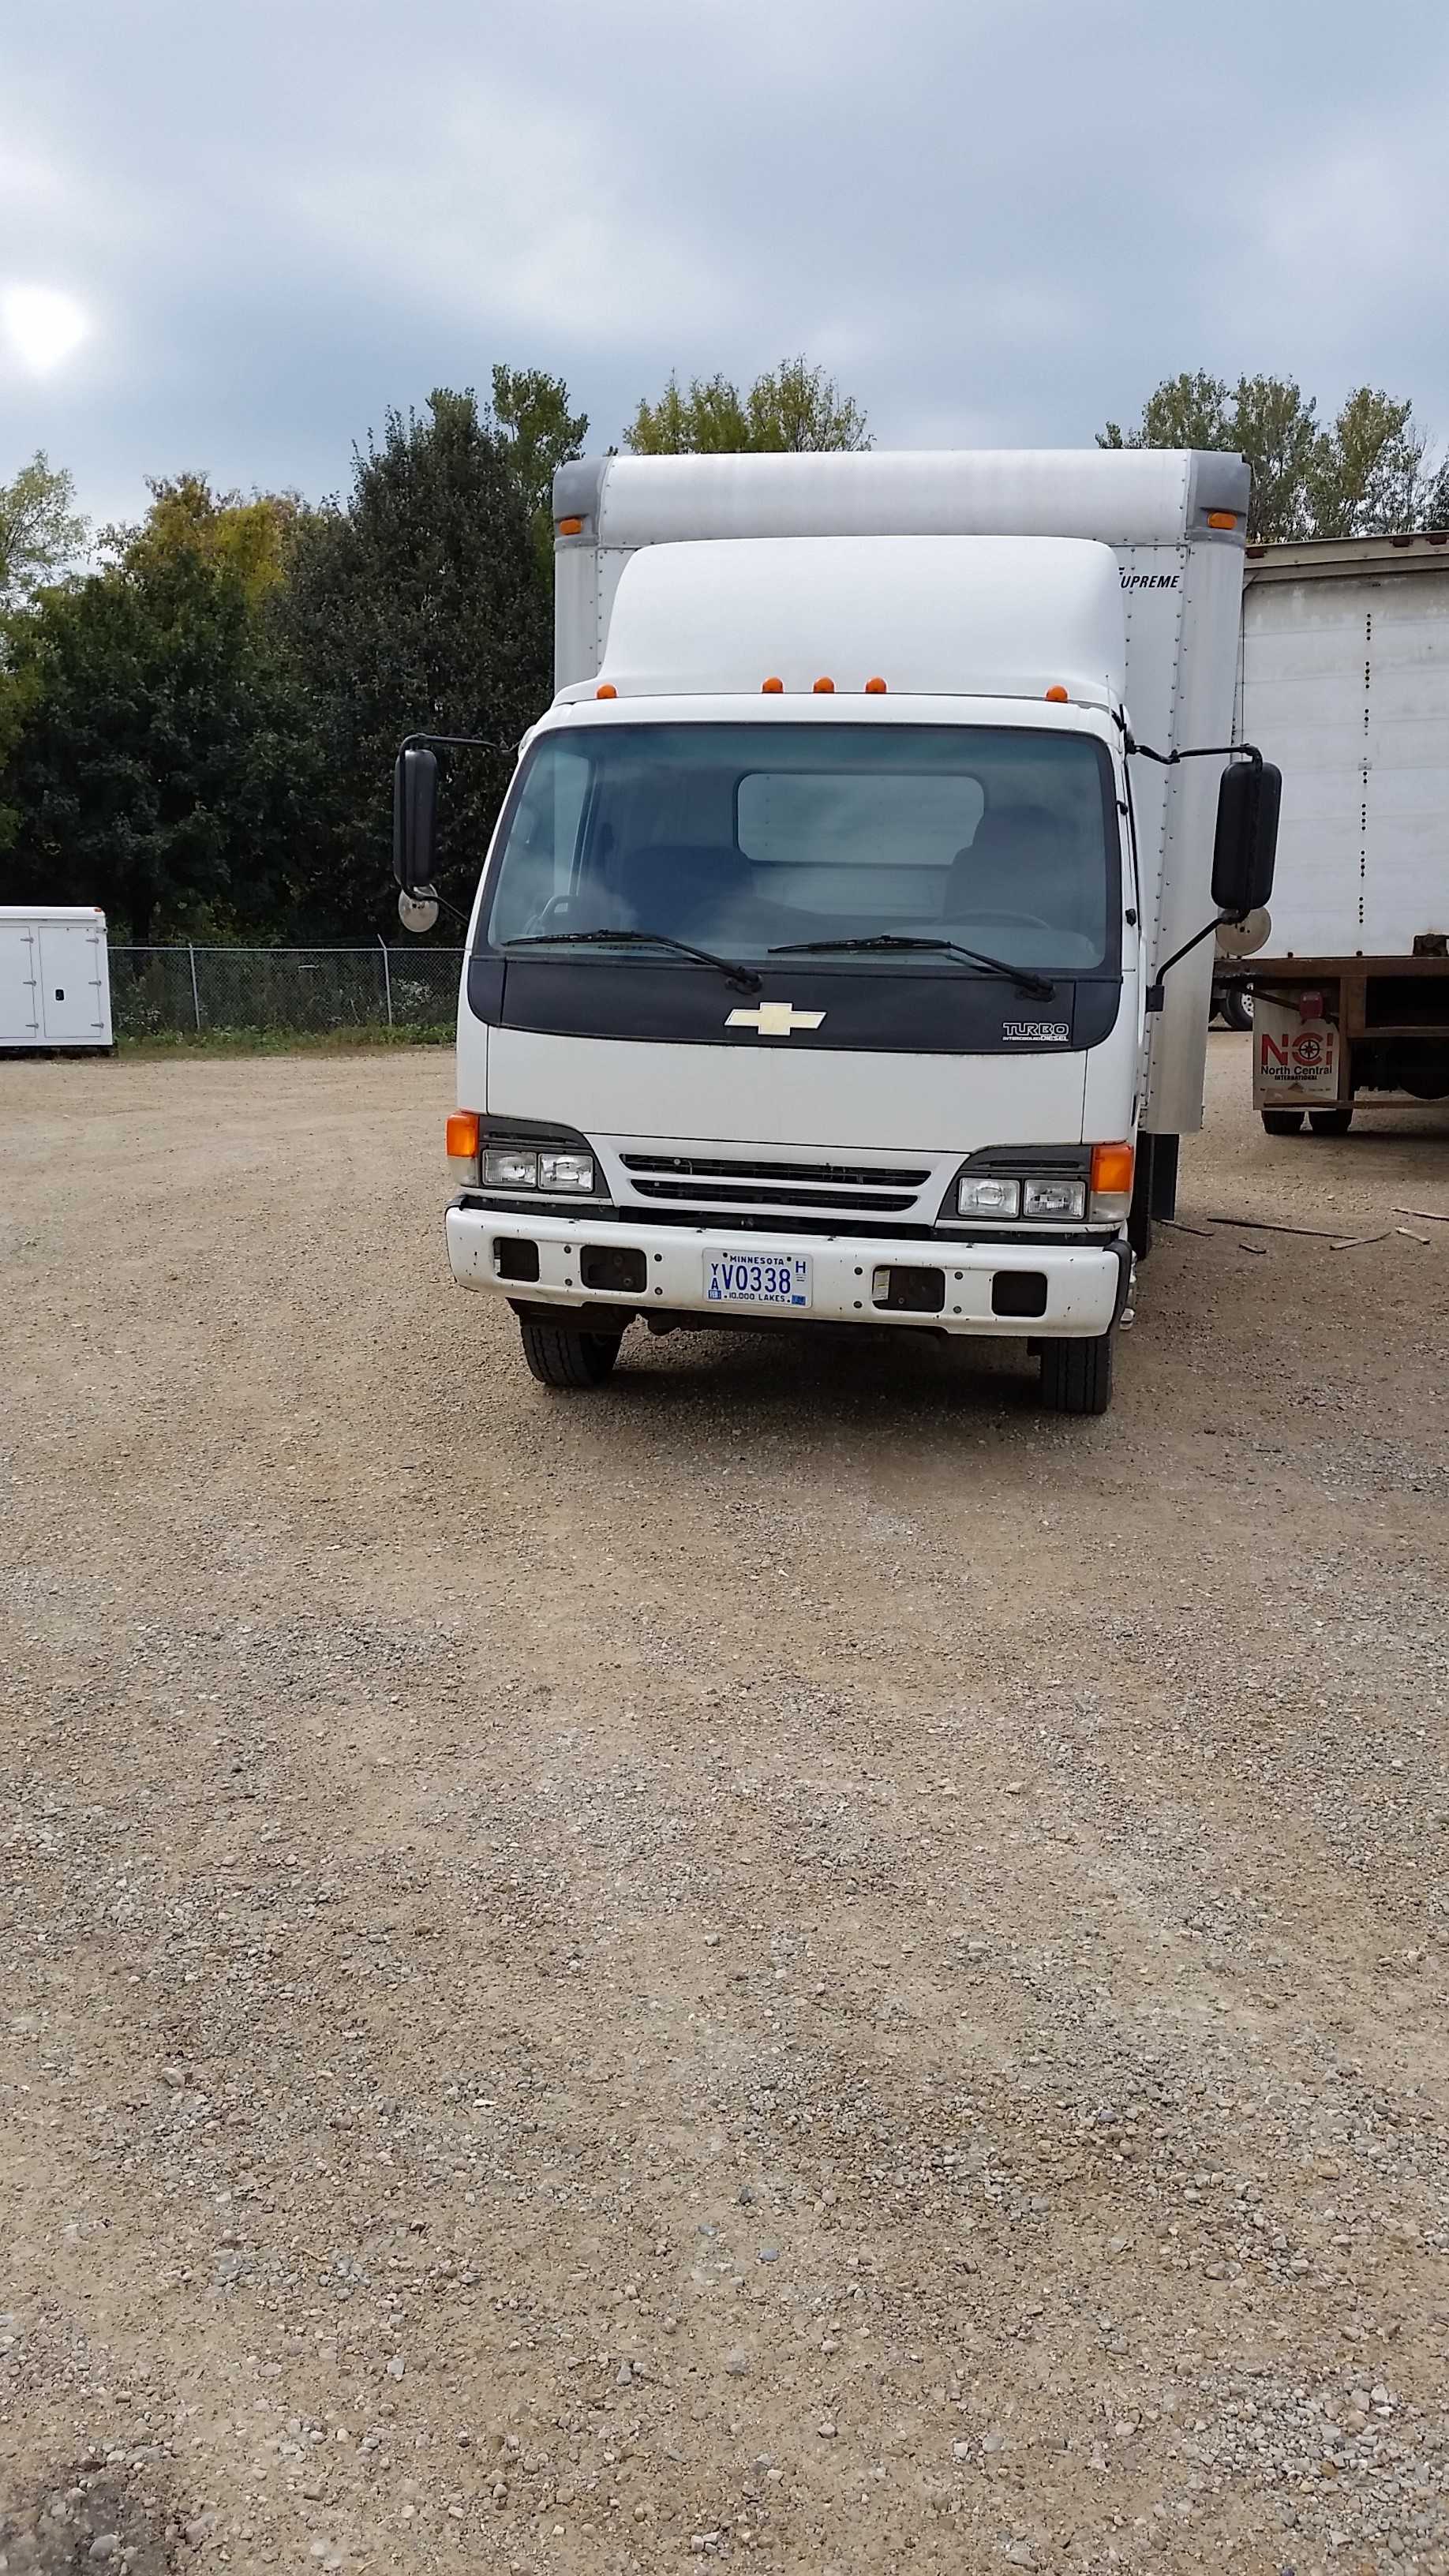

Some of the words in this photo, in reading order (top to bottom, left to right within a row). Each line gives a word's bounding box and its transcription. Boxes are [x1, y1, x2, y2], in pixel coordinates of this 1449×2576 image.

[1118, 568, 1180, 589] UPREME
[1003, 1023, 1069, 1035] TURBO
[1262, 1032, 1334, 1066] NCI
[1261, 1065, 1290, 1075] North
[1294, 1065, 1332, 1075] Central
[729, 1255, 784, 1265] MINNESOTA
[796, 1260, 806, 1274] H
[721, 1264, 791, 1294] V0338
[758, 1294, 785, 1302] LAKES
